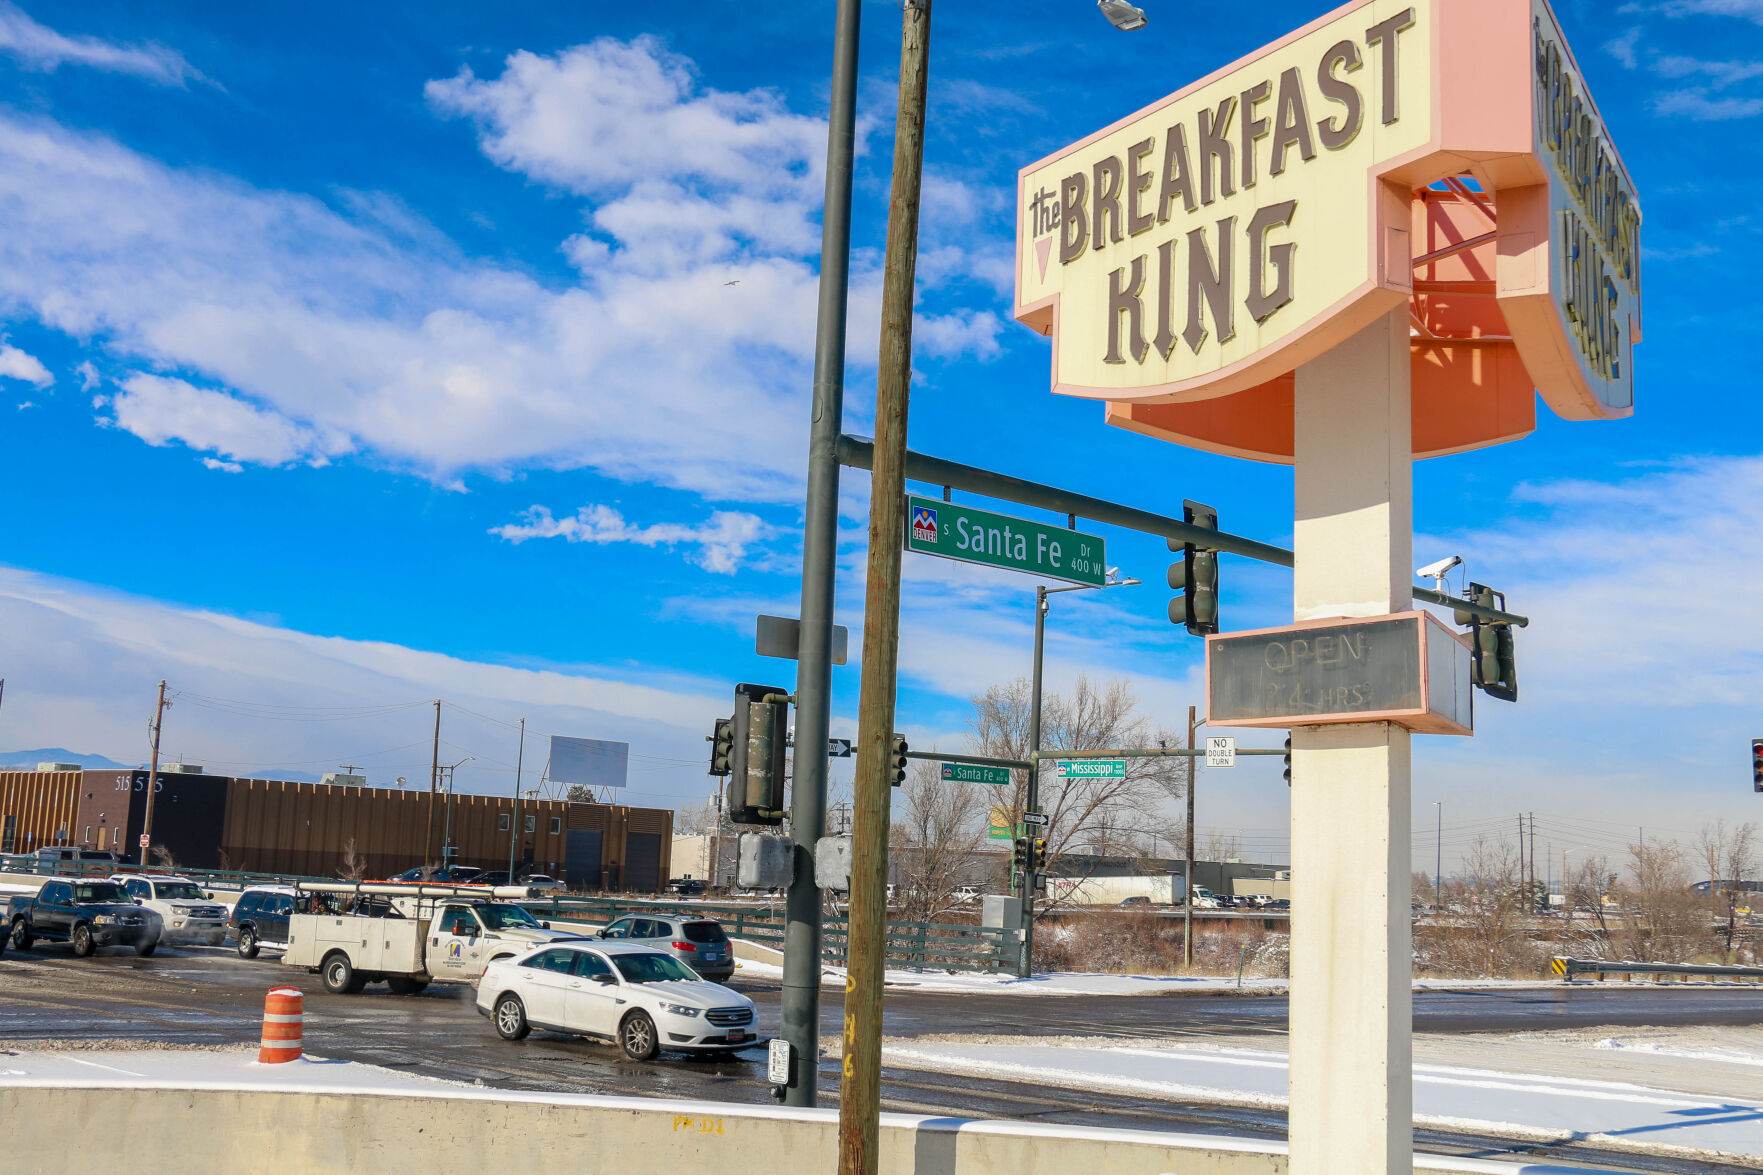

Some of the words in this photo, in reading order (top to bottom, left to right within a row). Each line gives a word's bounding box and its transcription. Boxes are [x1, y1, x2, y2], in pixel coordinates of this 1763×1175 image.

[1029, 187, 1061, 239] the
[1060, 7, 1416, 265] BREAKFAST
[1103, 200, 1298, 365] KING
[913, 528, 937, 543] DENVER
[943, 523, 949, 536] S
[956, 516, 1027, 561] Santa
[1037, 533, 1062, 568] Fe
[1081, 543, 1091, 558] Dr
[1071, 559, 1089, 573] 400
[1093, 562, 1101, 576] W
[1264, 631, 1369, 673] OPEN
[1320, 683, 1365, 709] HRS
[1213, 738, 1227, 748] NO
[1208, 749, 1232, 757] DOUBLE
[957, 767, 981, 780] Santa
[983, 769, 994, 781] Fe
[1071, 762, 1114, 776] Mississippi
[115, 775, 131, 791] 515
[134, 776, 164, 793] 55
